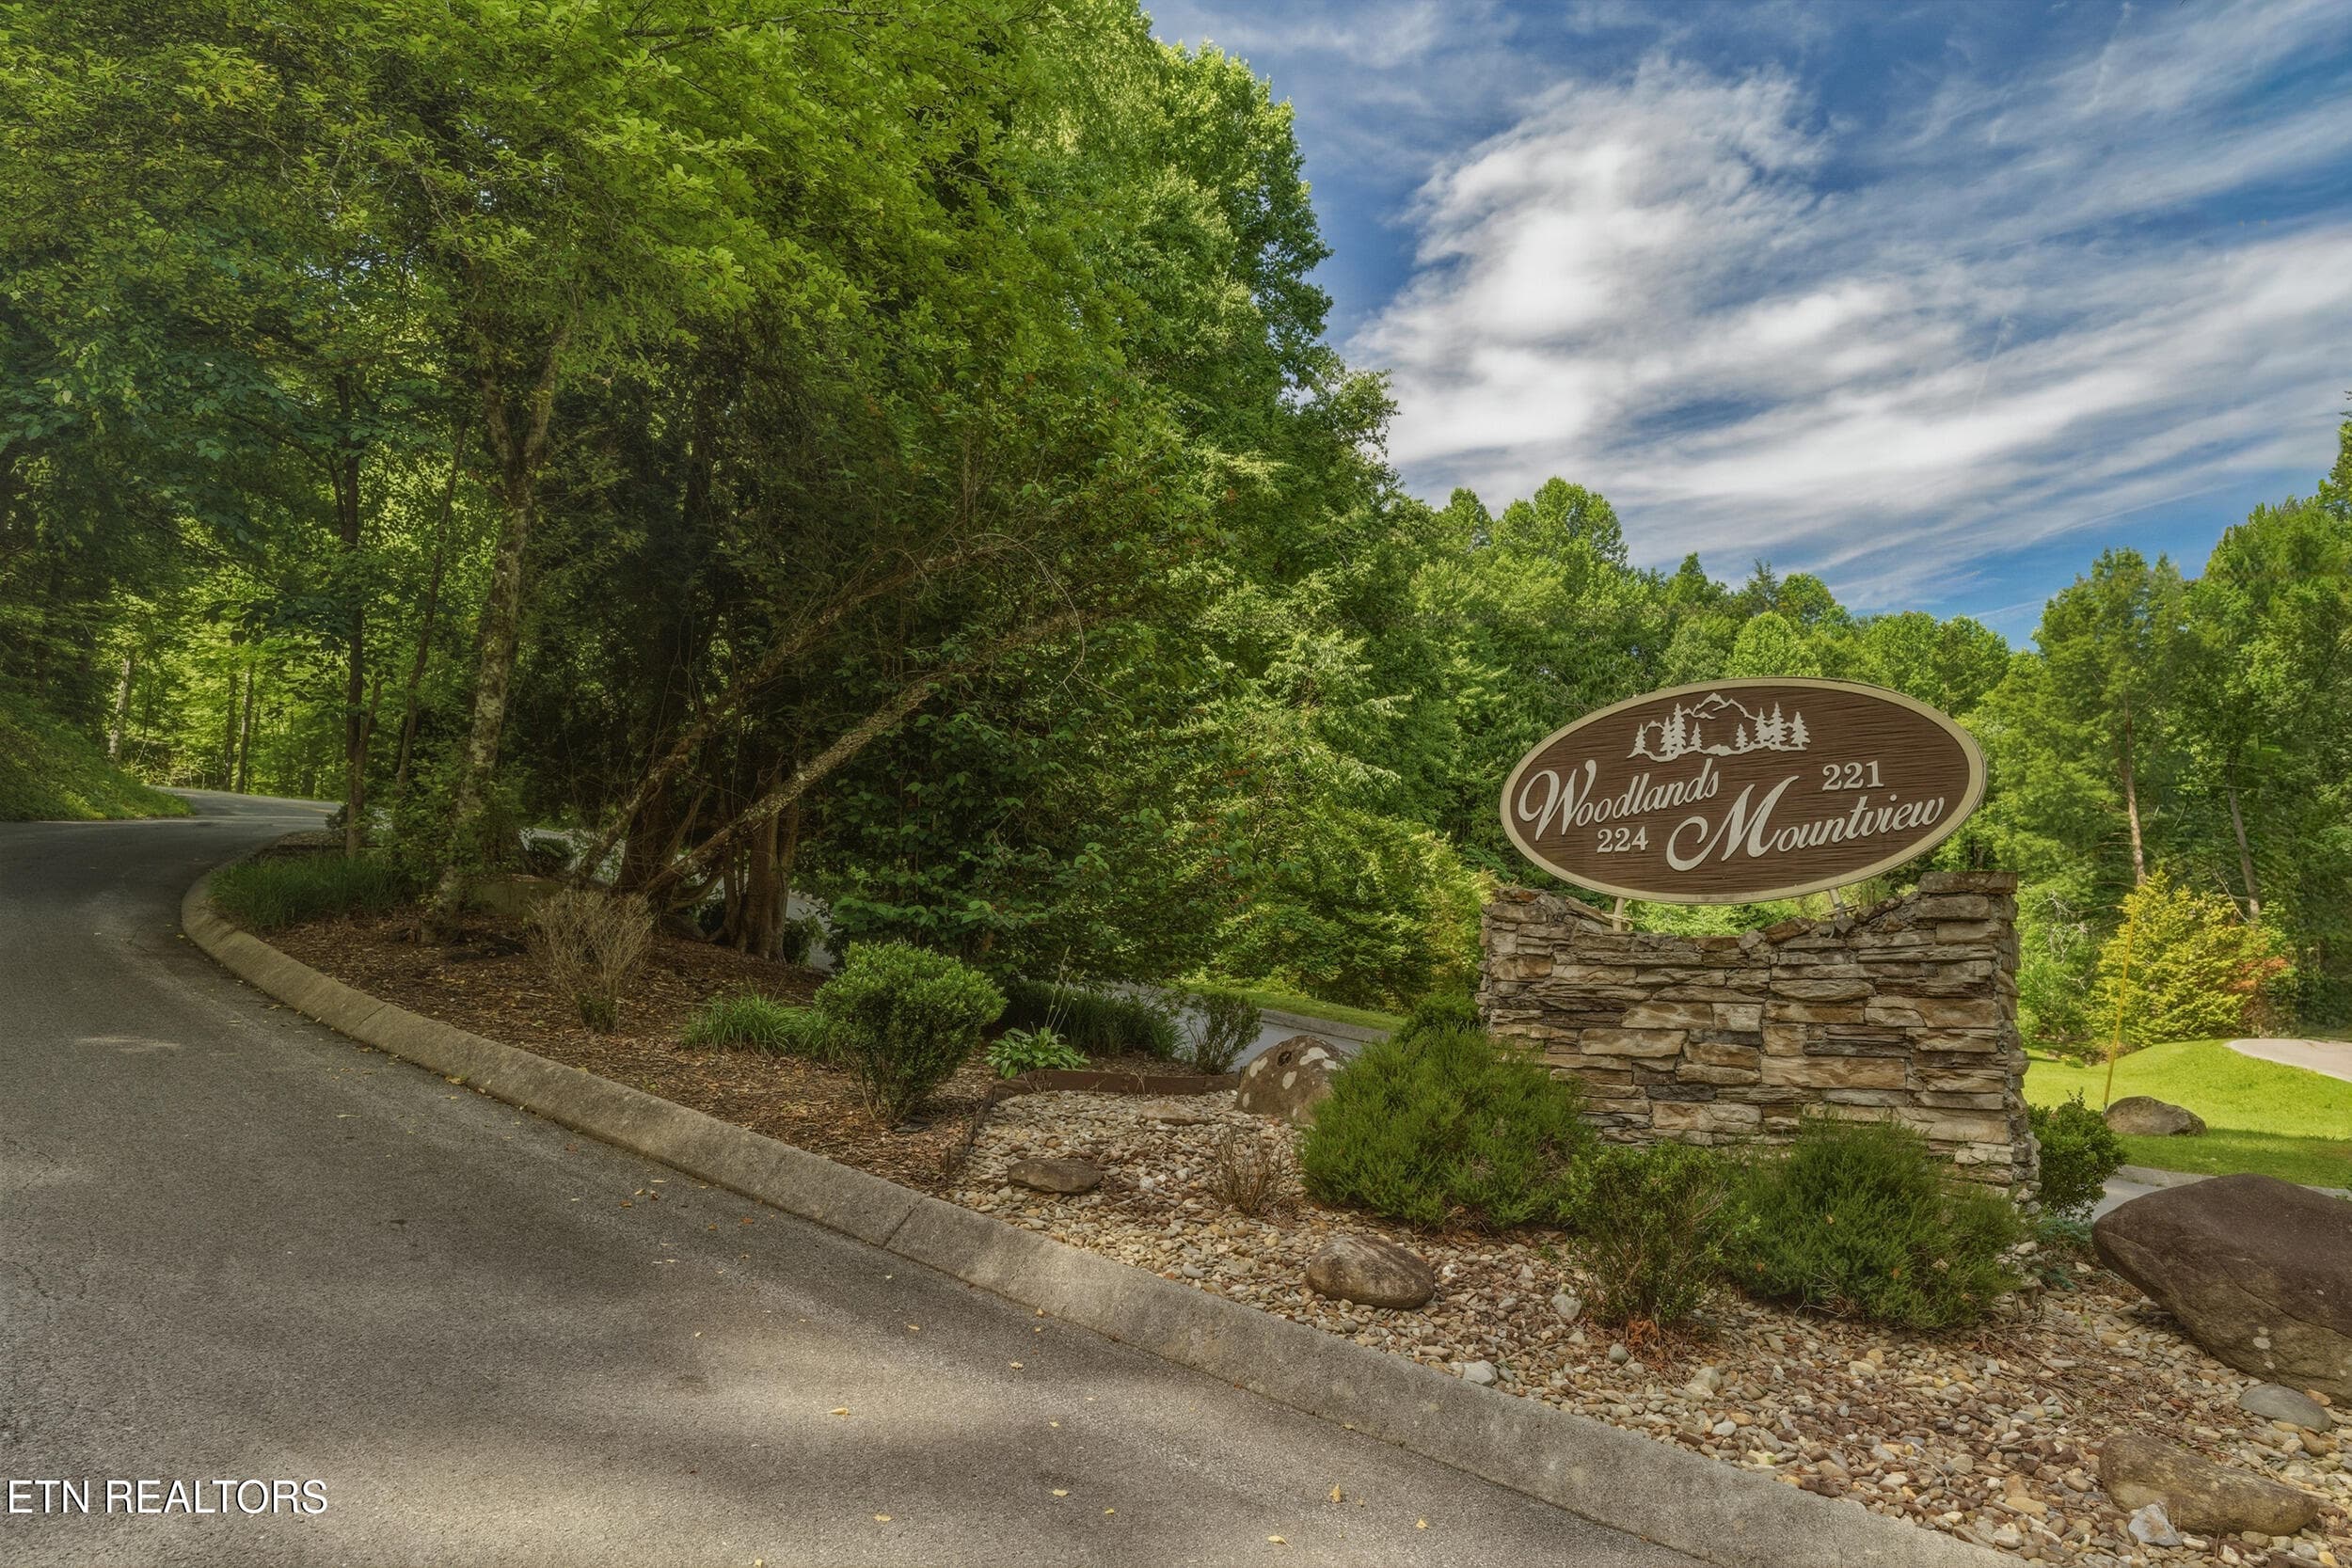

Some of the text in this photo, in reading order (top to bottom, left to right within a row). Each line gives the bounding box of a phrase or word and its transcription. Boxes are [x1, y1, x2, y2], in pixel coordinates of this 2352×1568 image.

[1517, 757, 1720, 842] Woodlands
[1821, 759, 1885, 792] 221
[1596, 826, 1649, 855] 224
[1666, 774, 1946, 871] Mountview
